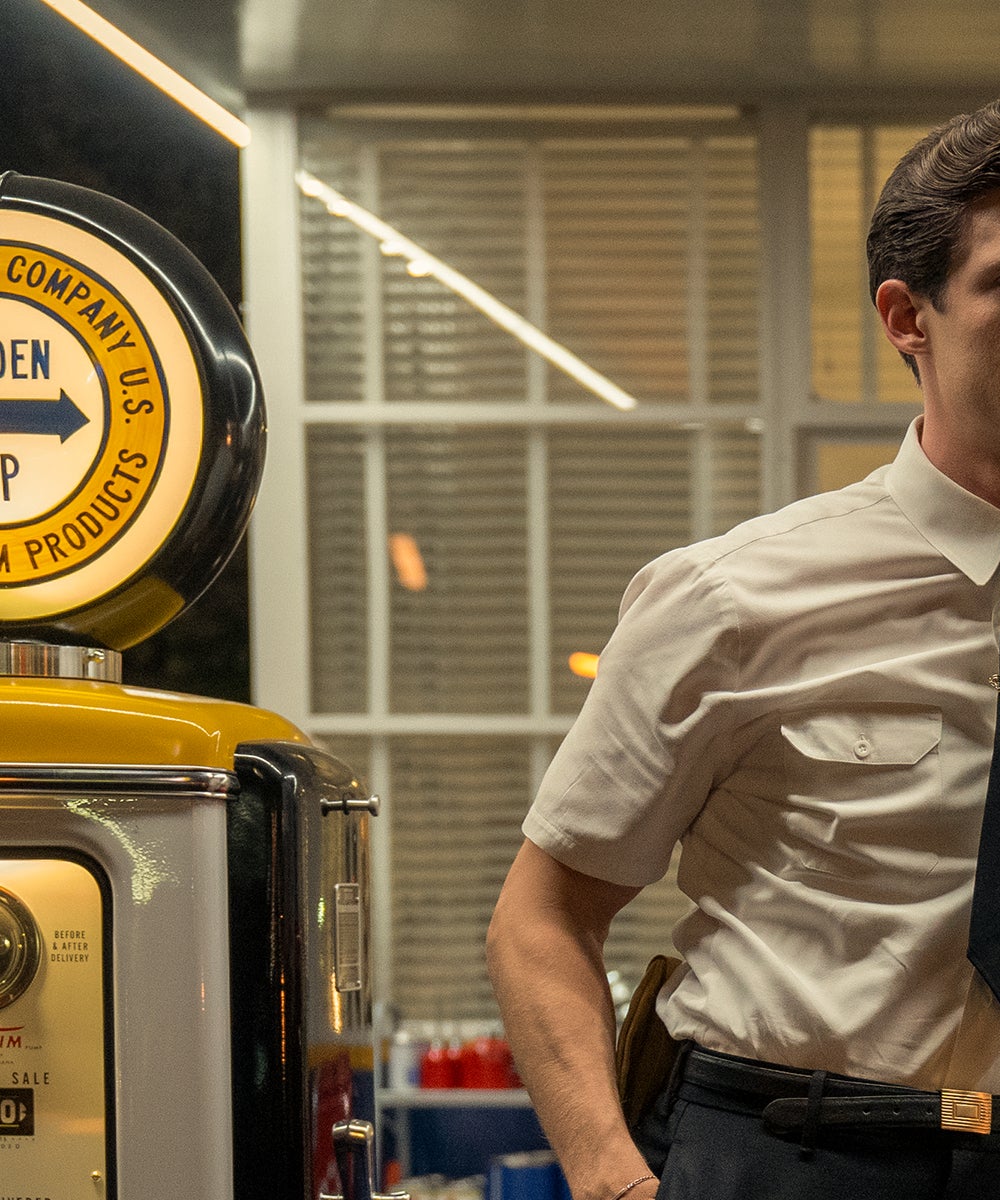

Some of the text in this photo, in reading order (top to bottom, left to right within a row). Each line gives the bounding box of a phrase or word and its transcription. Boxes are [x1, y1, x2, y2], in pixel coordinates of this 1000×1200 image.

[7, 254, 154, 425] COMPANY U.S.
[25, 448, 148, 570] PRODUCTS
[53, 930, 87, 940] BEFORE
[52, 941, 89, 951] & AFTER
[50, 953, 90, 963] DELIVERY
[11, 1071, 50, 1086] SALE
